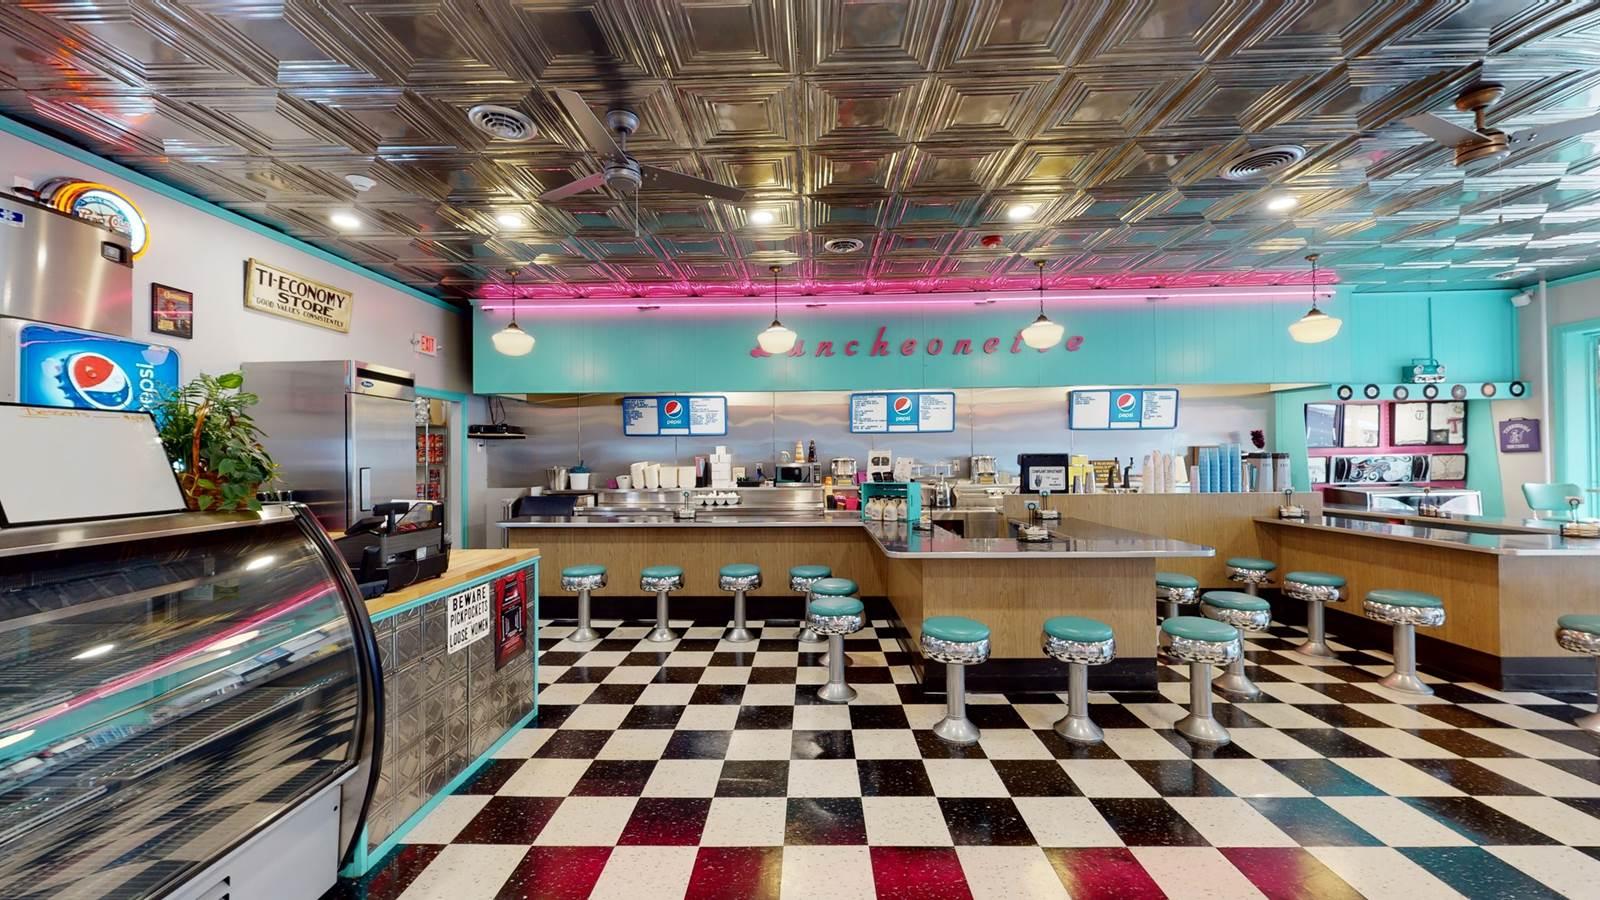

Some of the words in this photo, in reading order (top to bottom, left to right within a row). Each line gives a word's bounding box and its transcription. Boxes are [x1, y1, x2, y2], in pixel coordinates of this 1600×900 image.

[255, 267, 345, 309] TI-ECONOMY
[256, 297, 274, 308] GOOD
[276, 302, 300, 315] VALUES
[302, 311, 344, 328] CONSISTENTLY
[278, 292, 334, 318] STORE
[421, 335, 434, 352] EXIT
[751, 325, 1084, 357] uncheonete
[453, 587, 486, 611] BEWARE
[450, 600, 488, 627] PICKPOCKETS
[449, 628, 468, 648] LOOSE
[470, 619, 488, 636] WOMEN
